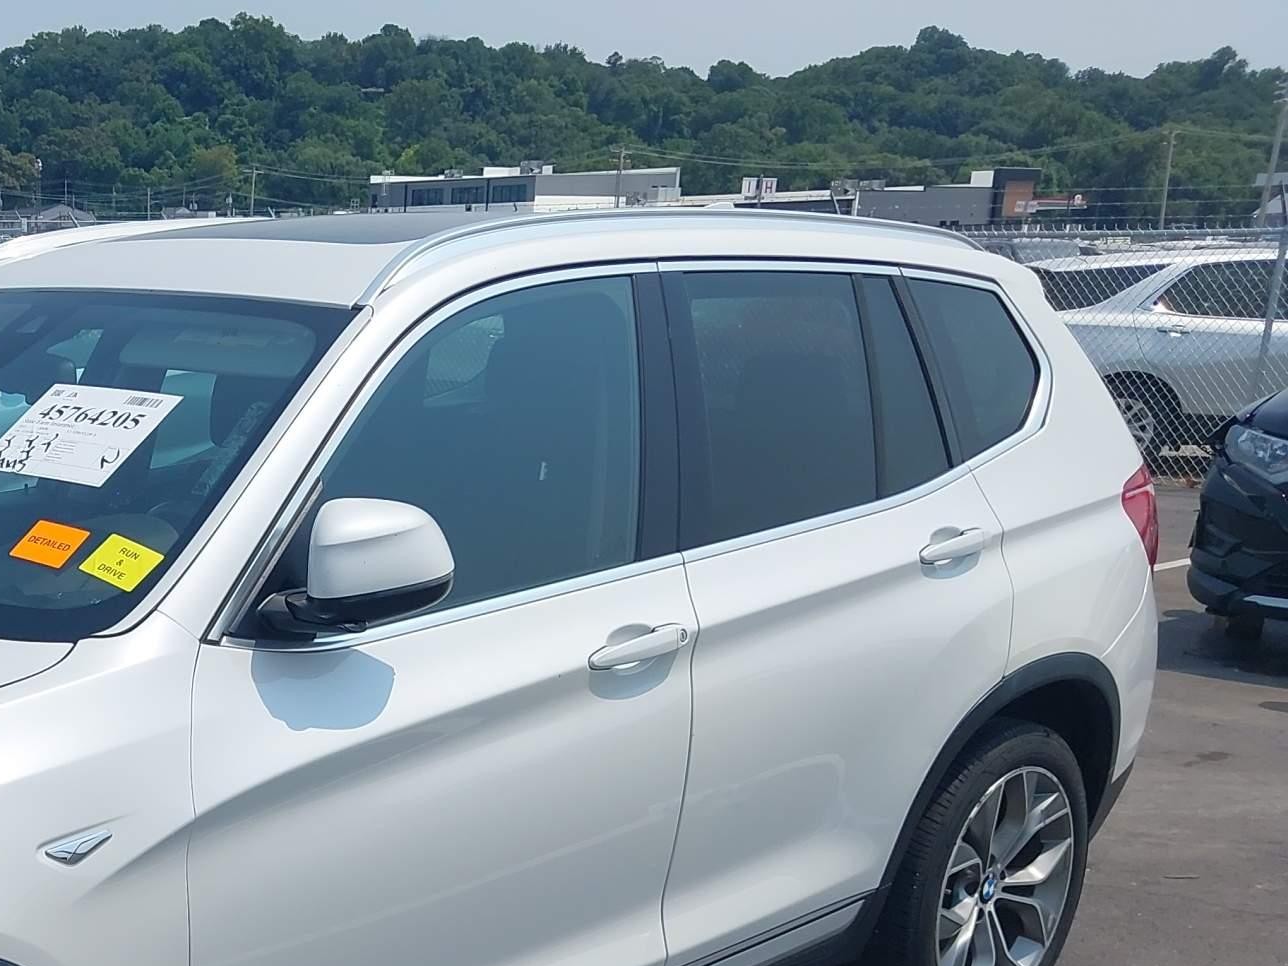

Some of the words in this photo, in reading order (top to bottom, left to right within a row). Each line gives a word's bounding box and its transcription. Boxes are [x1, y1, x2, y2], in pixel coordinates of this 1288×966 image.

[39, 403, 147, 430] 45764205
[27, 535, 71, 552] DETAILED
[119, 547, 140, 561] RUN
[97, 563, 127, 580] DRIVE
[115, 559, 125, 567] &
